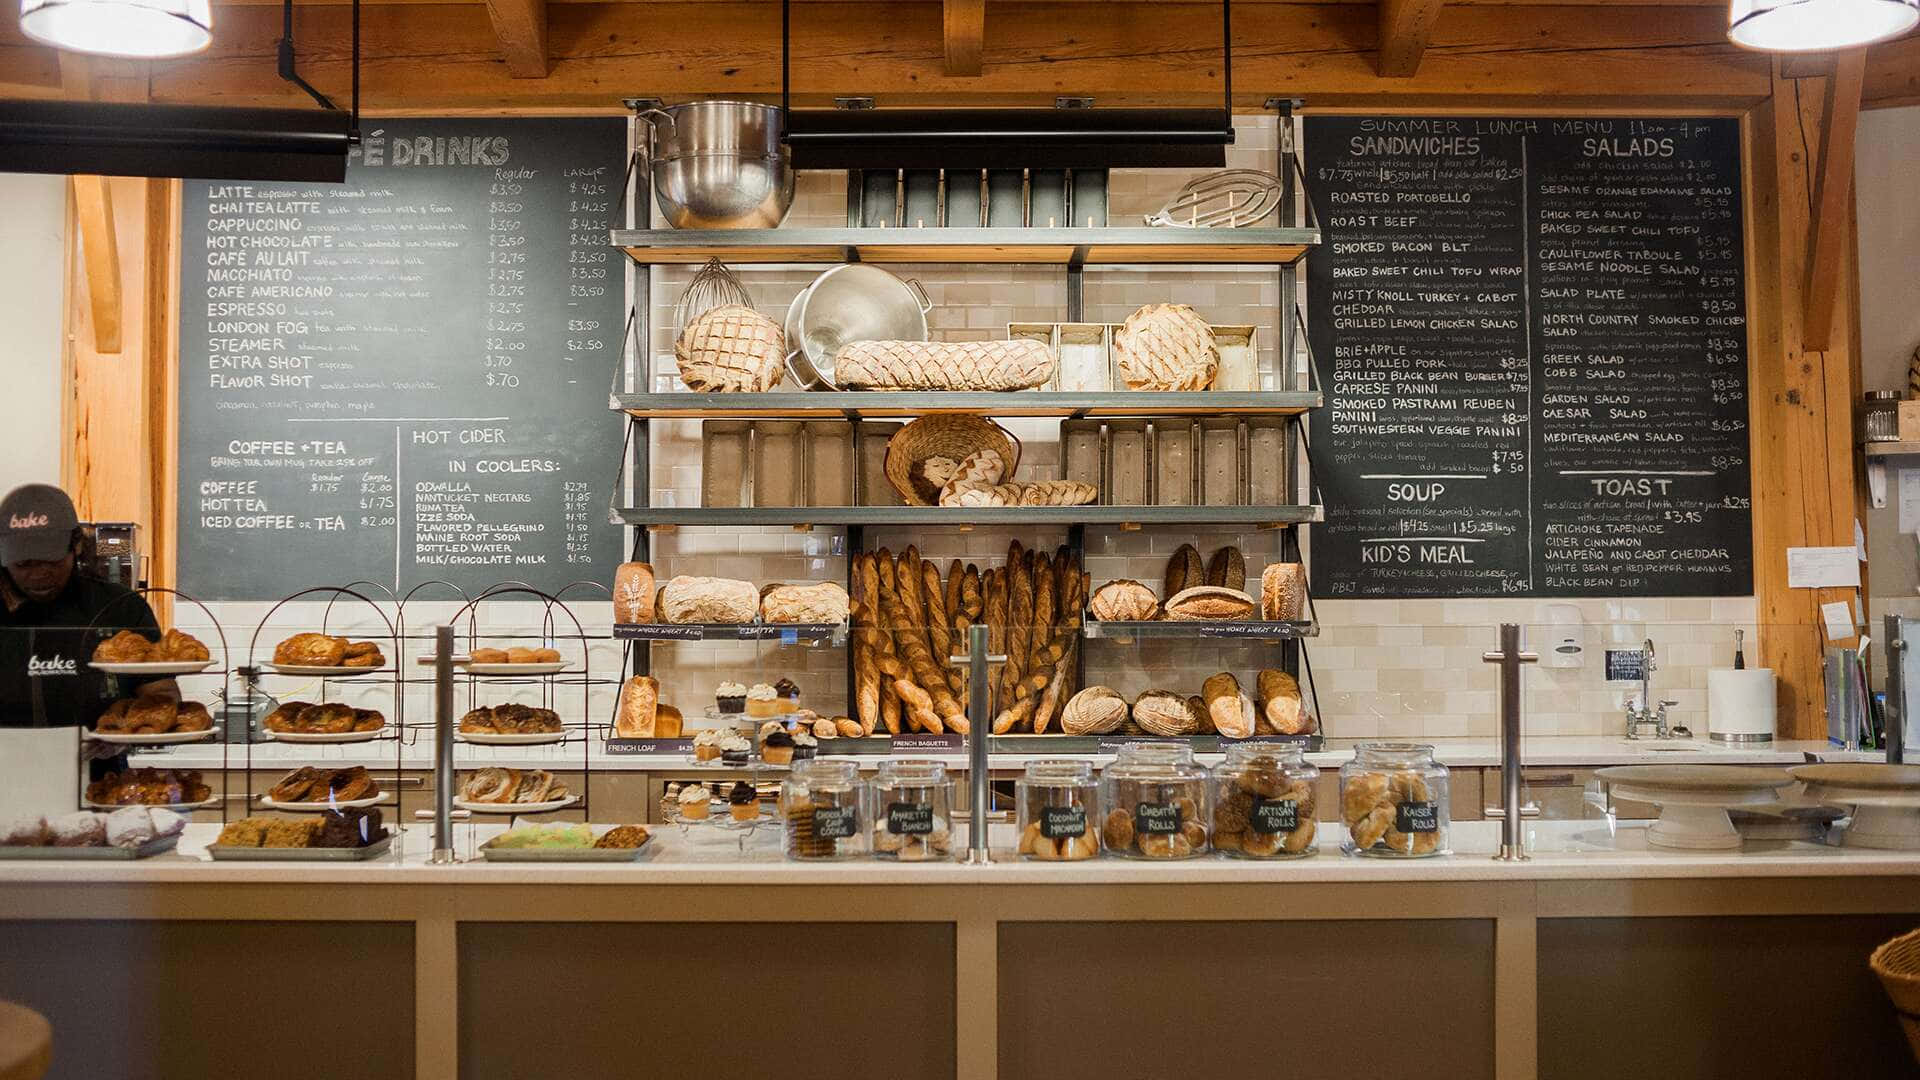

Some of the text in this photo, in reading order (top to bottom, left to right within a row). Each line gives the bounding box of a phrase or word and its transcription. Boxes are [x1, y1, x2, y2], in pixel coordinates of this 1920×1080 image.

[1360, 119, 1460, 133] SUMMER
[1476, 120, 1538, 135] LUNCH
[1553, 121, 1613, 135] MENU
[392, 136, 510, 167] DRINKS
[1350, 136, 1480, 156] SANDWICHES
[1583, 138, 1675, 157] SALADS
[208, 186, 254, 199] LATTE
[1331, 192, 1390, 204] ROASTED
[209, 202, 321, 215] CHAI TEA LATTE
[569, 202, 608, 213] $4.25
[1540, 210, 1571, 220] CHICK
[1576, 210, 1599, 220] PEA
[1604, 210, 1643, 220] SALAD
[207, 218, 302, 232] CAPPUCCINO
[569, 218, 608, 231] $4.25
[1331, 217, 1379, 228] ROAST
[1384, 216, 1418, 227] BEEF
[1540, 223, 1626, 234] BAKED SWEET
[207, 236, 237, 248] HOT
[240, 235, 333, 248] CHOCOLATE
[1333, 242, 1433, 254] SMOKED BACON
[255, 250, 311, 266] AU LAIT
[569, 251, 607, 263] $3.50
[1539, 249, 1623, 260] CAULIFLOWER
[571, 268, 606, 279] $3.50
[1333, 266, 1523, 278] BAKED SWEET CHILI TOFU WRAP
[1541, 262, 1594, 272] SESAME
[1600, 263, 1651, 274] NOODLE
[1659, 265, 1700, 275] SALAD
[207, 268, 293, 282] MACCHIATO
[251, 286, 333, 297] AMERICANO
[570, 285, 605, 297] $3.50
[1333, 290, 1518, 302] MISTY KNOLL TURKEY CABOT
[1540, 288, 1580, 298] SALAD
[207, 303, 286, 316] ESPRESSO
[1333, 304, 1395, 316] CHEDDAR
[1335, 318, 1519, 329] GRILLED LEMON CHICKEN SALAD
[1648, 315, 1700, 325] SMOKED
[208, 321, 309, 334] LONDON FOG
[1543, 327, 1578, 337] SALAD
[208, 338, 286, 352] STEAMER
[209, 355, 313, 369] EXTRA SHOT
[1366, 358, 1447, 369] PULLED PORK
[1542, 354, 1583, 365] GREEK
[1587, 354, 1625, 365] SALAD
[1333, 370, 1459, 381] GRILLED BLACK BEAN
[1586, 369, 1626, 379] SALAD
[210, 374, 265, 388] FLAVOR
[270, 374, 313, 388] SHOT
[1333, 383, 1439, 395] CAPRESE PANINI
[1333, 398, 1516, 410] SMOKED PASTRAMI REUBEN
[1542, 393, 1631, 405] GARDEN SALAD
[1332, 411, 1377, 423] PANINI
[1542, 408, 1593, 418] CAESAR
[413, 429, 506, 444] HOT CIDER
[1332, 424, 1521, 437] SOUTHWESTERN PANINI
[1645, 432, 1685, 443] SALAD
[229, 440, 295, 455] COFFEE
[449, 461, 466, 473] IN
[201, 480, 258, 494] COFFEE
[1387, 483, 1446, 501] SOUP
[1592, 478, 1673, 496] TOAST
[233, 498, 267, 512] TEA
[9, 512, 48, 529] bake
[202, 516, 231, 528] ICED
[235, 515, 295, 529] COFFEE
[314, 515, 346, 530] TEA
[416, 524, 473, 533] FLAVORED
[1545, 524, 1665, 534] ARTICHOKE TAPENADE
[416, 533, 522, 543] MAINE ROOT SODA
[1545, 537, 1579, 547] CIDER
[416, 544, 468, 553] BOTTLED
[1420, 545, 1474, 564] MEAL
[1670, 549, 1730, 560] CHEDDAR
[28, 654, 77, 670] bake
[608, 744, 636, 752] FRENCH
[637, 744, 657, 752] LOAF
[1258, 806, 1296, 816] ARTISAN
[1403, 806, 1433, 817] KAISER
[1148, 820, 1176, 831] ROLLS
[1267, 817, 1296, 828] ROLLS
[1411, 819, 1436, 829] ROLLS
